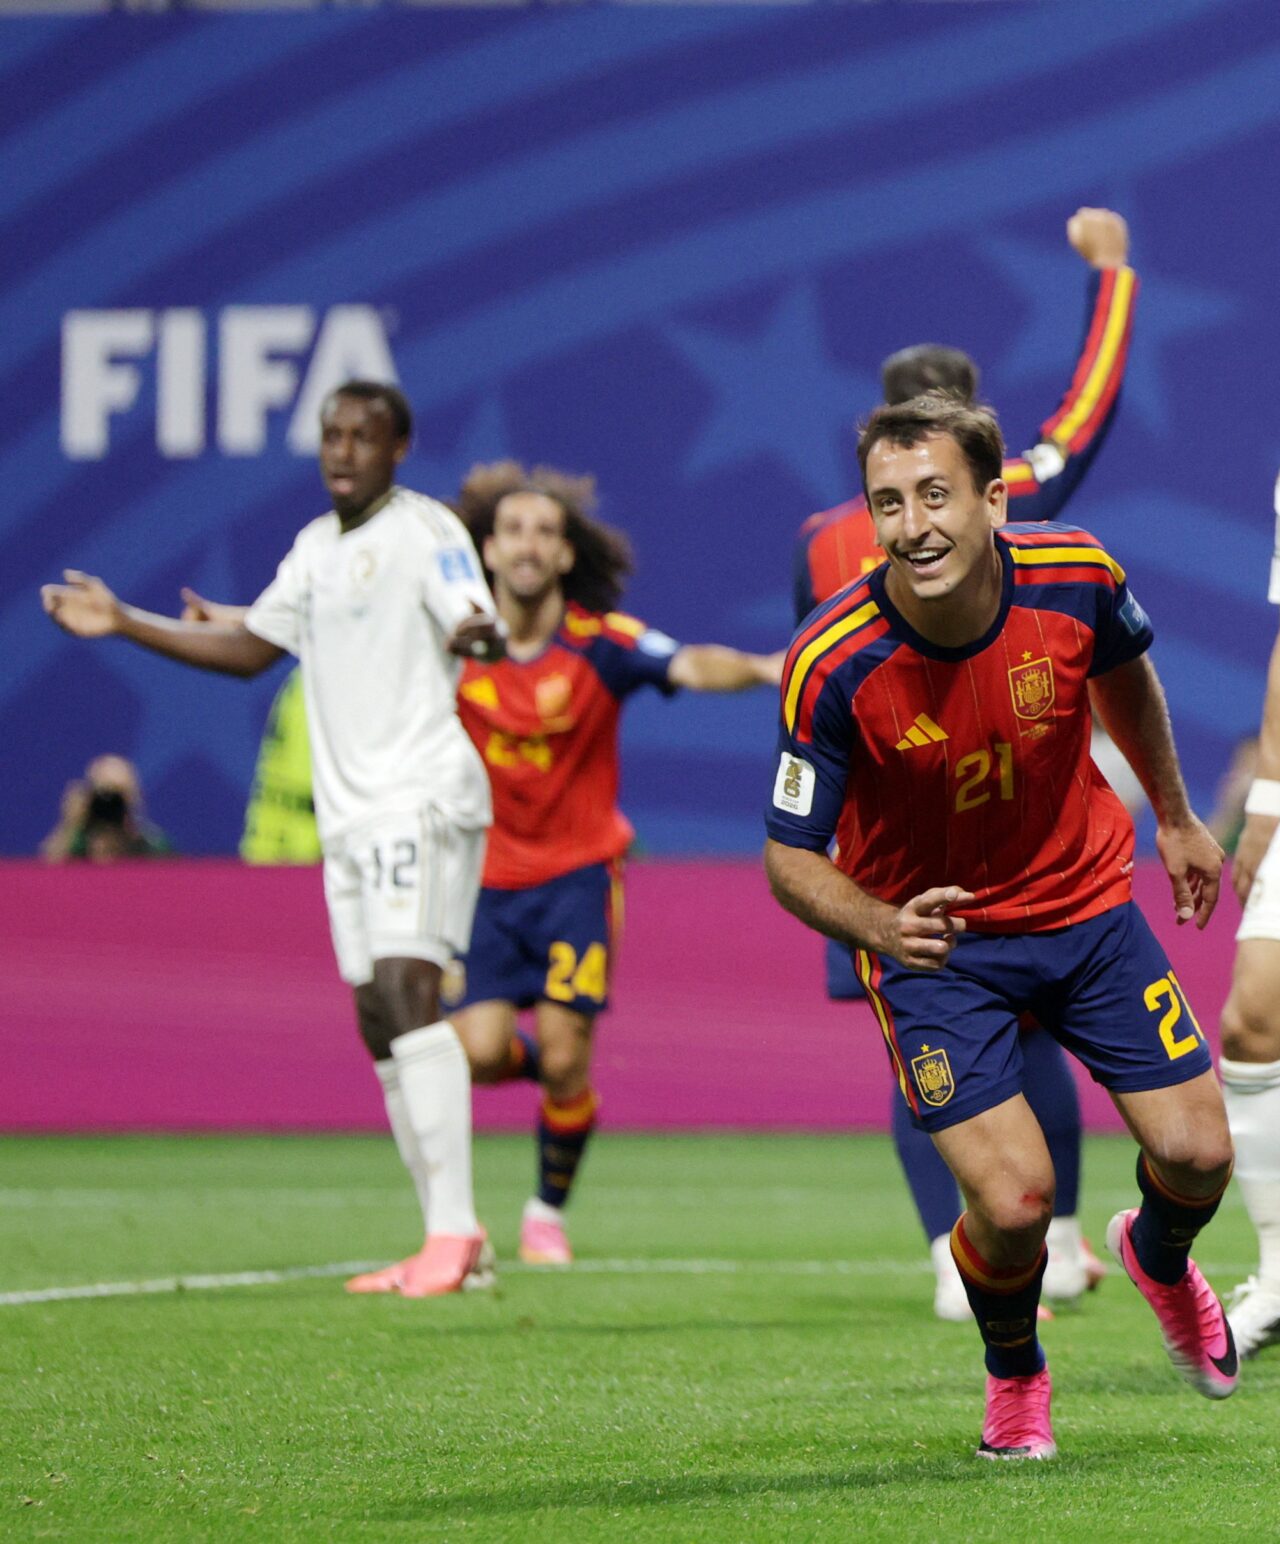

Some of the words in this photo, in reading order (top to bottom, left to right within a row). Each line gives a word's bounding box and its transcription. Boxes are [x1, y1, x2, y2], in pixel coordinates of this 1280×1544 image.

[61, 303, 400, 461] FIFA
[955, 743, 1014, 814] 21
[373, 839, 416, 889] 12
[545, 941, 606, 1003] 24
